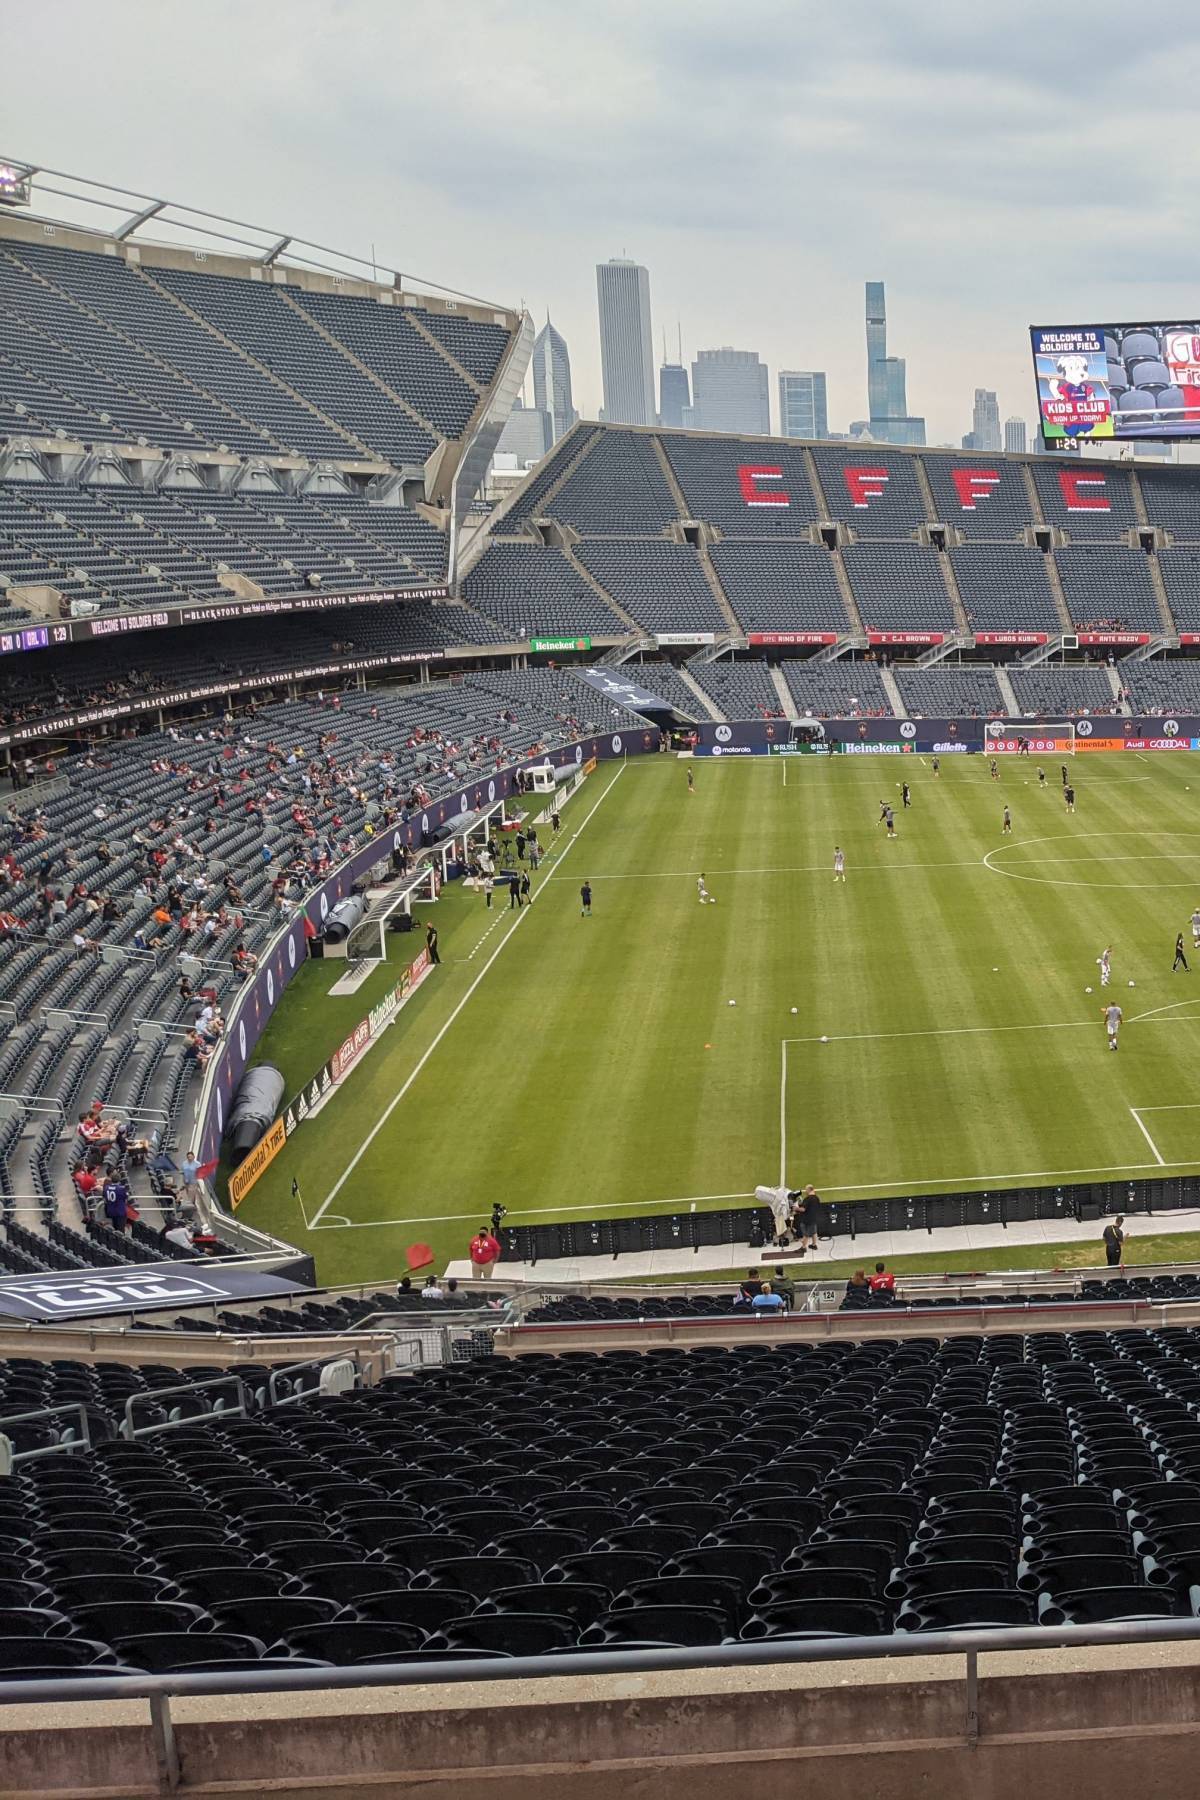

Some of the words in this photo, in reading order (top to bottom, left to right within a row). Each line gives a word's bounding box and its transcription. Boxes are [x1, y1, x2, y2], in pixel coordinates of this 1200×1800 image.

[1042, 333, 1083, 343] WELCOME
[1085, 333, 1096, 341] TO
[1040, 343, 1074, 352] SOLDIER
[1077, 342, 1100, 350] FIELD
[1048, 402, 1073, 414] KIDS
[1077, 402, 1106, 412] CLUB
[1056, 438, 1078, 450] 1:29
[301, 593, 346, 608] BLACKSTONE
[403, 589, 447, 599] BLACKSTONE
[191, 606, 240, 620] BLACKSTONE
[91, 618, 119, 635] WELCOME
[119, 616, 128, 631] TO
[128, 614, 152, 630] SOLDIER
[152, 612, 169, 626] FIELD
[41, 629, 46, 644] 0
[53, 627, 67, 641] 1:29
[778, 635, 795, 643] RING
[796, 635, 806, 643] OF
[807, 635, 823, 643] FIRE
[16, 633, 21, 649] 0
[535, 640, 575, 650] Heineken
[348, 657, 388, 670] BLACKSTONE
[249, 673, 293, 688] BLACKSTONE
[141, 693, 189, 709] BLACKSTONE
[22, 718, 75, 739] BLACKSTONE
[722, 746, 751, 754] motorola
[845, 743, 901, 753] Heineken
[933, 743, 967, 752] Gillette
[368, 990, 397, 1036] Heineken
[232, 1144, 267, 1204] Continental
[269, 1126, 284, 1153] TIRE
[106, 1190, 117, 1203] 10
[823, 1290, 835, 1299] 124
